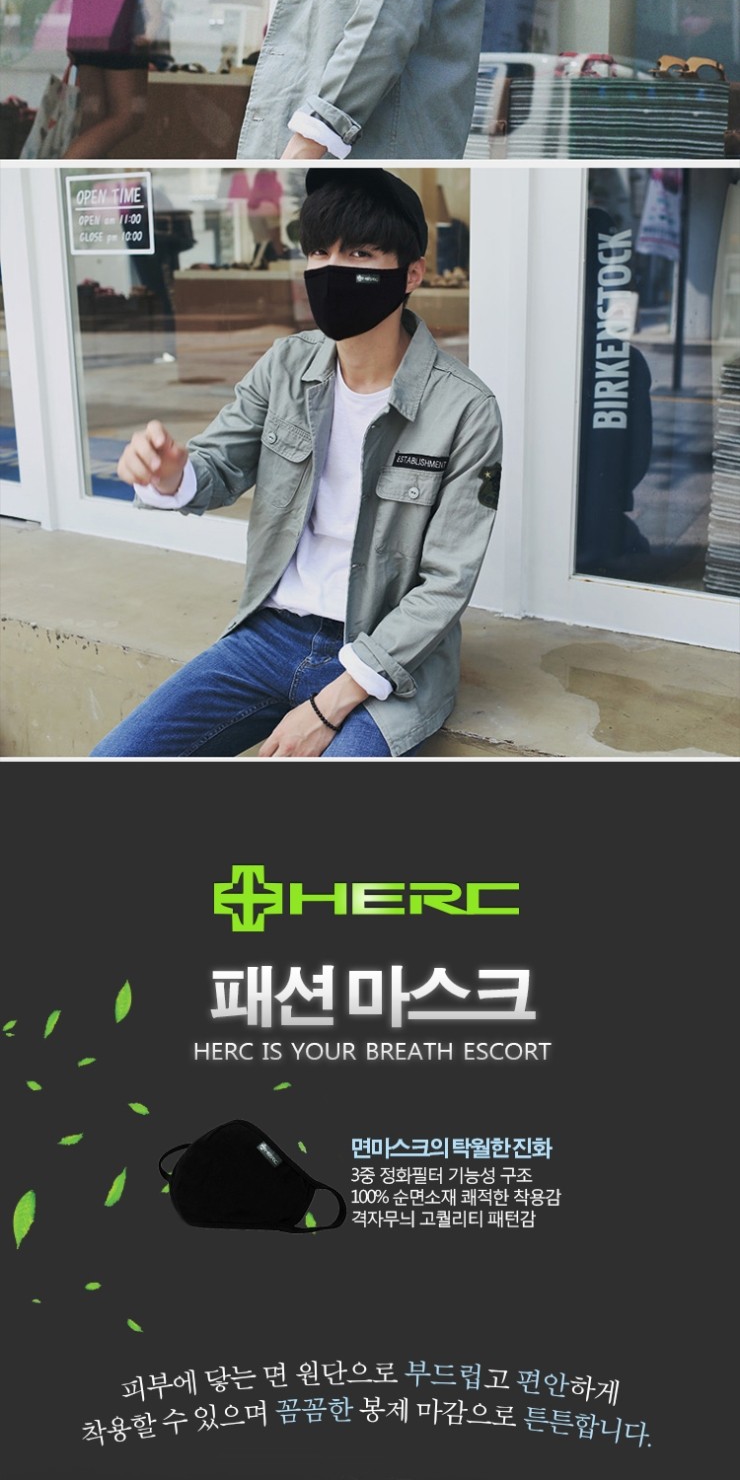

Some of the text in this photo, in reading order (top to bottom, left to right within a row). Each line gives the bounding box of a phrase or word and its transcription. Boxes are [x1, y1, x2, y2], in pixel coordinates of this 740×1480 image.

[76, 187, 142, 205] OPEN TIME
[78, 215, 101, 226] OPEN
[120, 214, 142, 225] 11:00
[122, 231, 143, 242] 10:00
[592, 228, 633, 430] BIRKENSTOCK
[396, 455, 448, 469] ESTABLISHMENT
